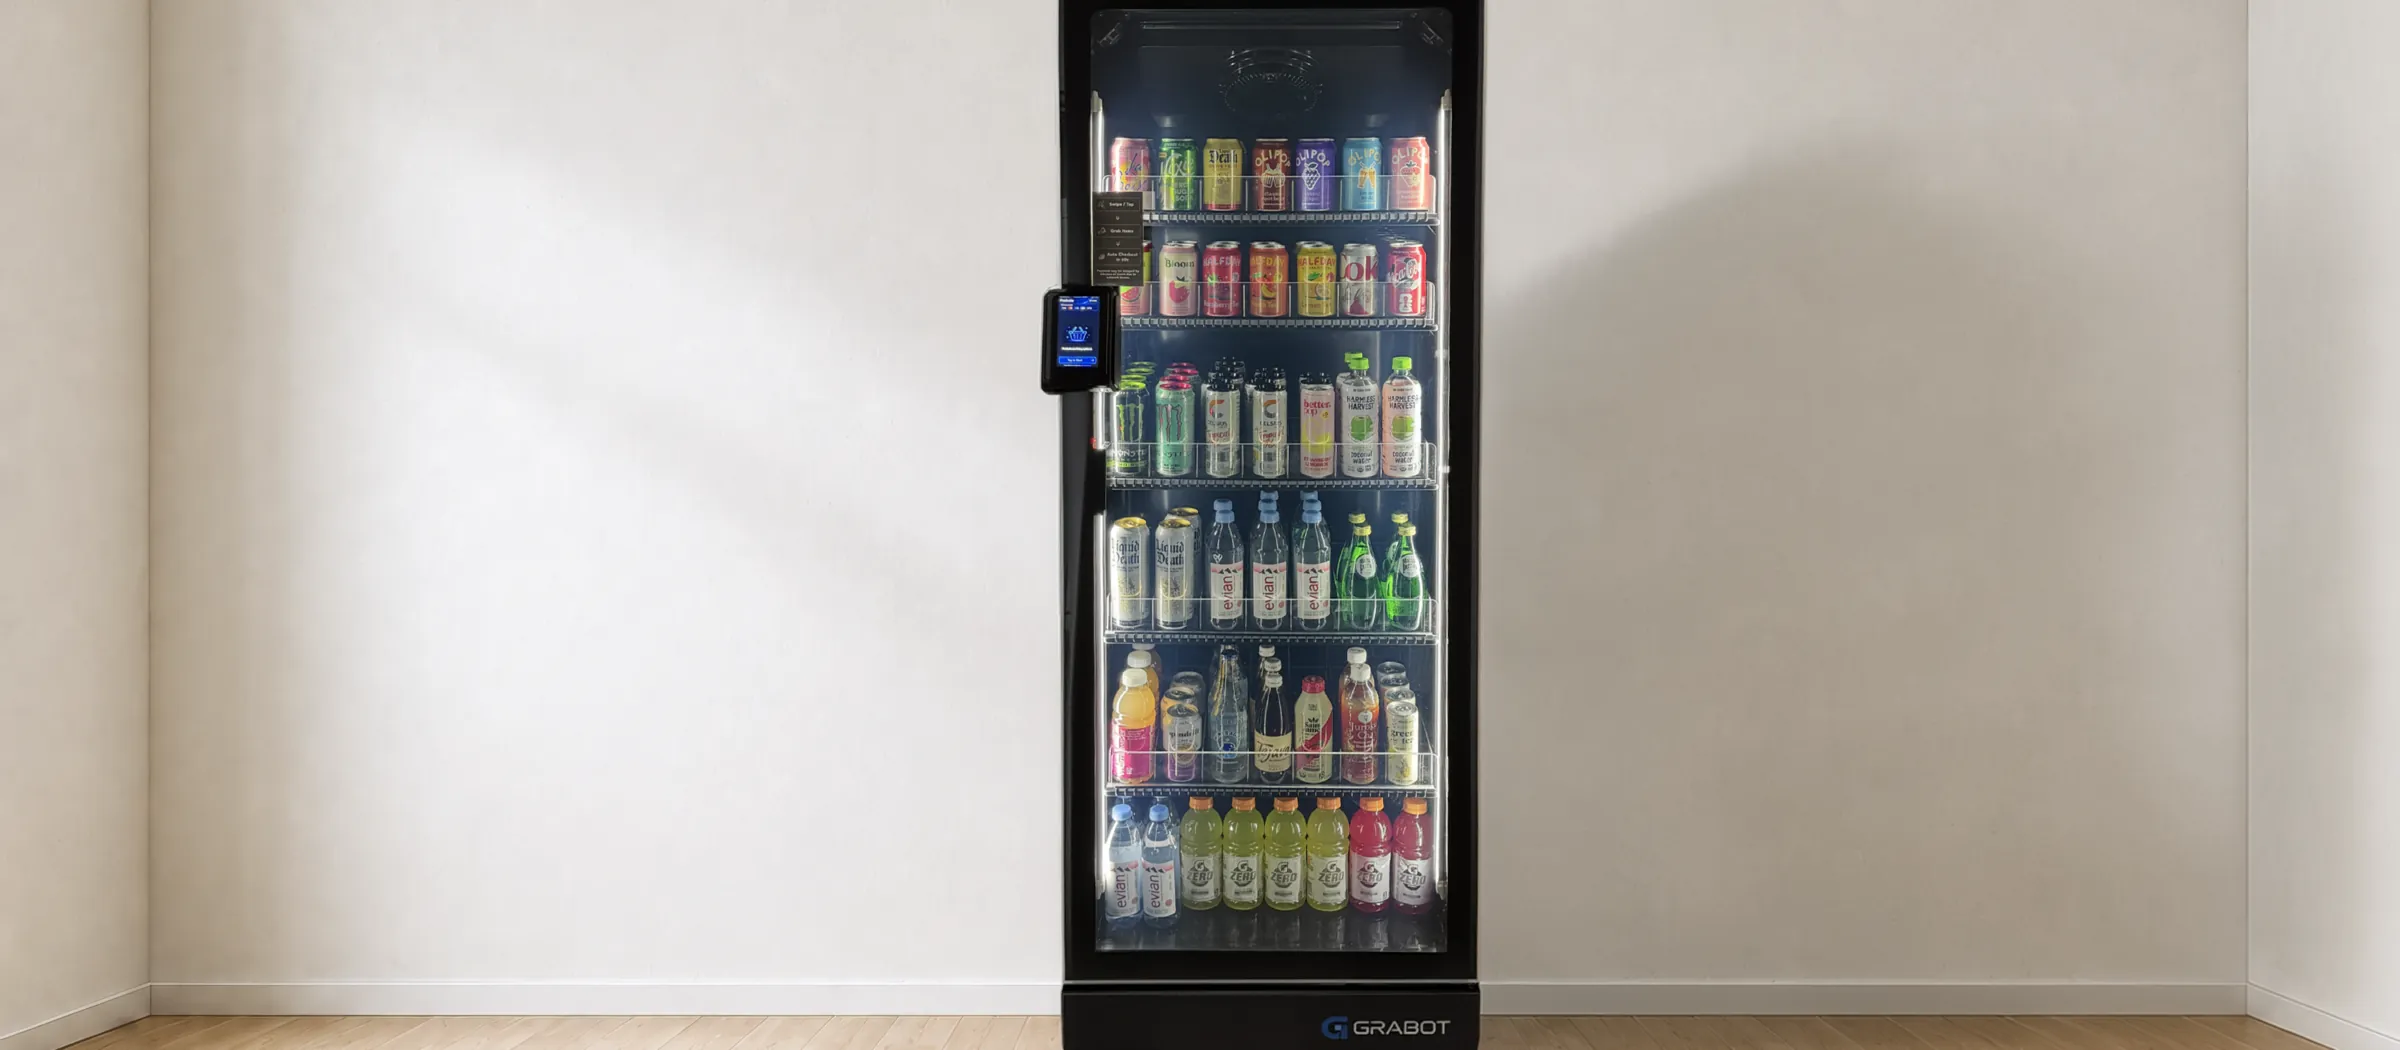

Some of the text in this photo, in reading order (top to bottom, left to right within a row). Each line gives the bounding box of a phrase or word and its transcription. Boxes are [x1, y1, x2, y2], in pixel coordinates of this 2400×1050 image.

[1255, 149, 1291, 167] OLIPOP
[1295, 149, 1331, 167] OLIPOP
[1165, 258, 1195, 268] Bloom
[1348, 402, 1374, 410] HARVEST
[1390, 402, 1415, 410] HARVEST
[1156, 539, 1185, 556] Liquid
[1222, 576, 1233, 610] evian
[1263, 576, 1274, 610] evian
[1307, 576, 1319, 610] evian
[1187, 872, 1213, 881] ZERO
[1231, 872, 1256, 881] ZERO
[1271, 872, 1298, 882] ZERO
[1318, 872, 1344, 882] ZERO
[1114, 874, 1127, 908] evian
[1149, 874, 1161, 908] evian
[1353, 1020, 1451, 1035] GRABOT
